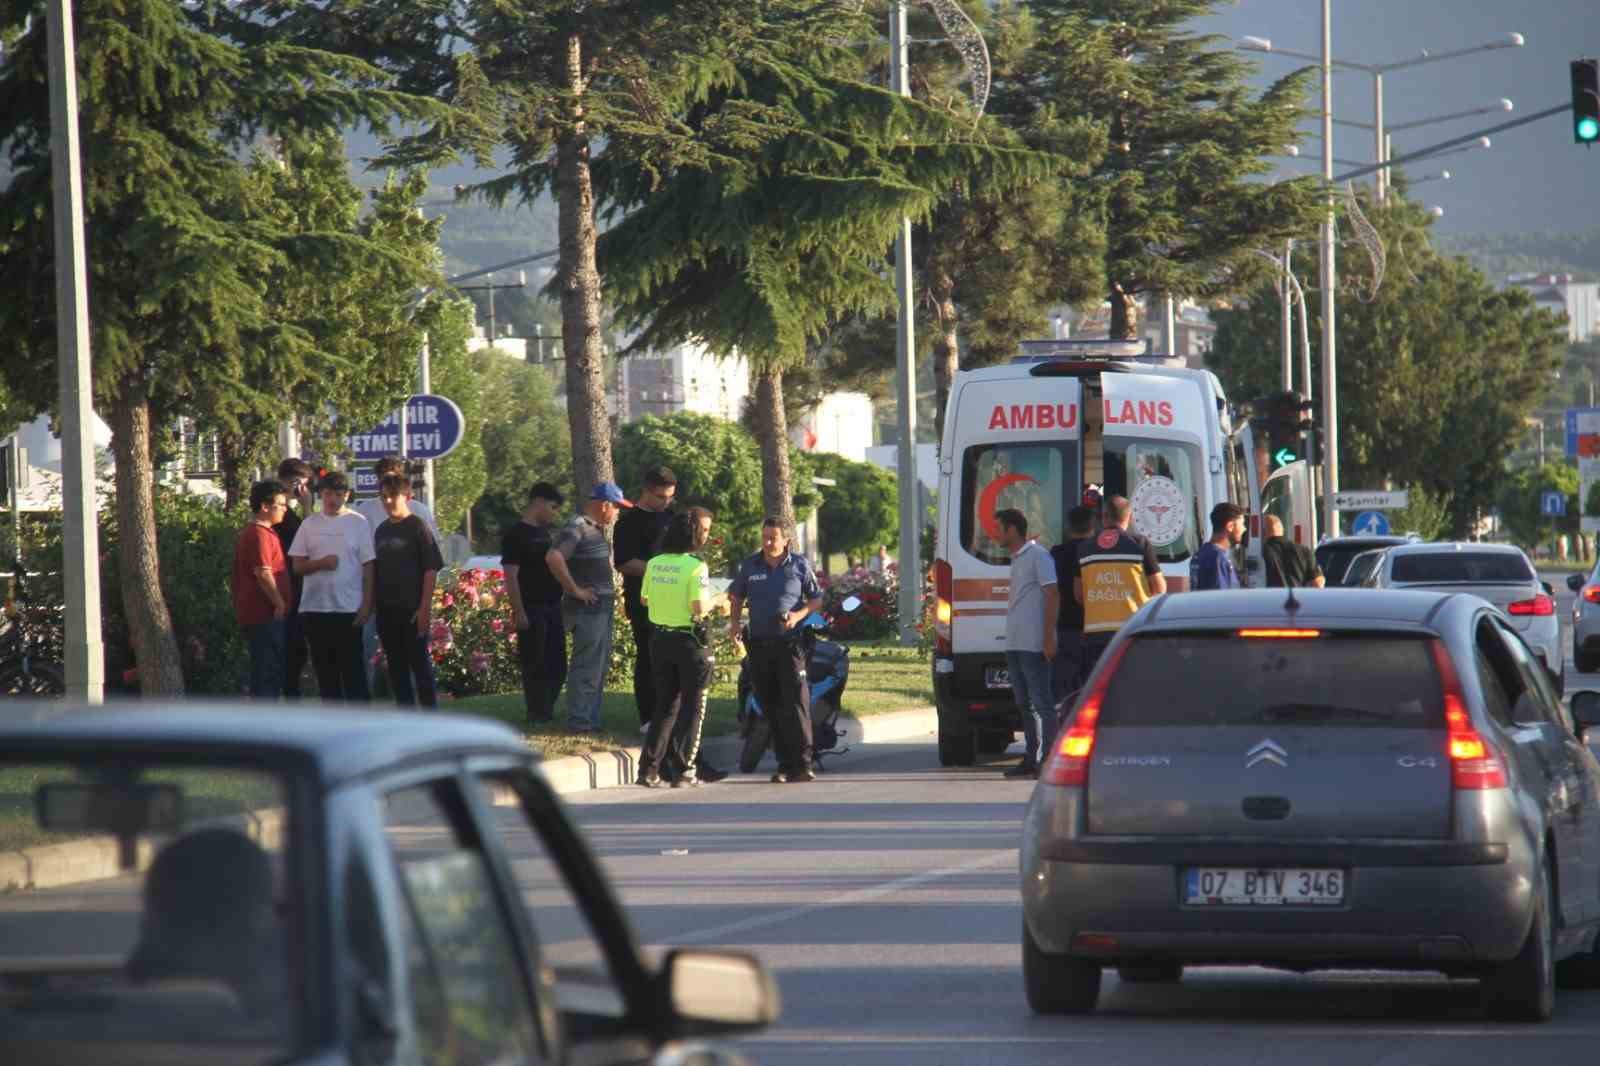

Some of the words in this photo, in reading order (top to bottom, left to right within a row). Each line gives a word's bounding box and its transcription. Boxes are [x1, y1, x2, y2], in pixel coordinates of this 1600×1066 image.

[1396, 756, 1437, 768] C4
[1201, 871, 1228, 896] 07
[1244, 871, 1286, 896] BTV
[1298, 871, 1340, 896] 346
